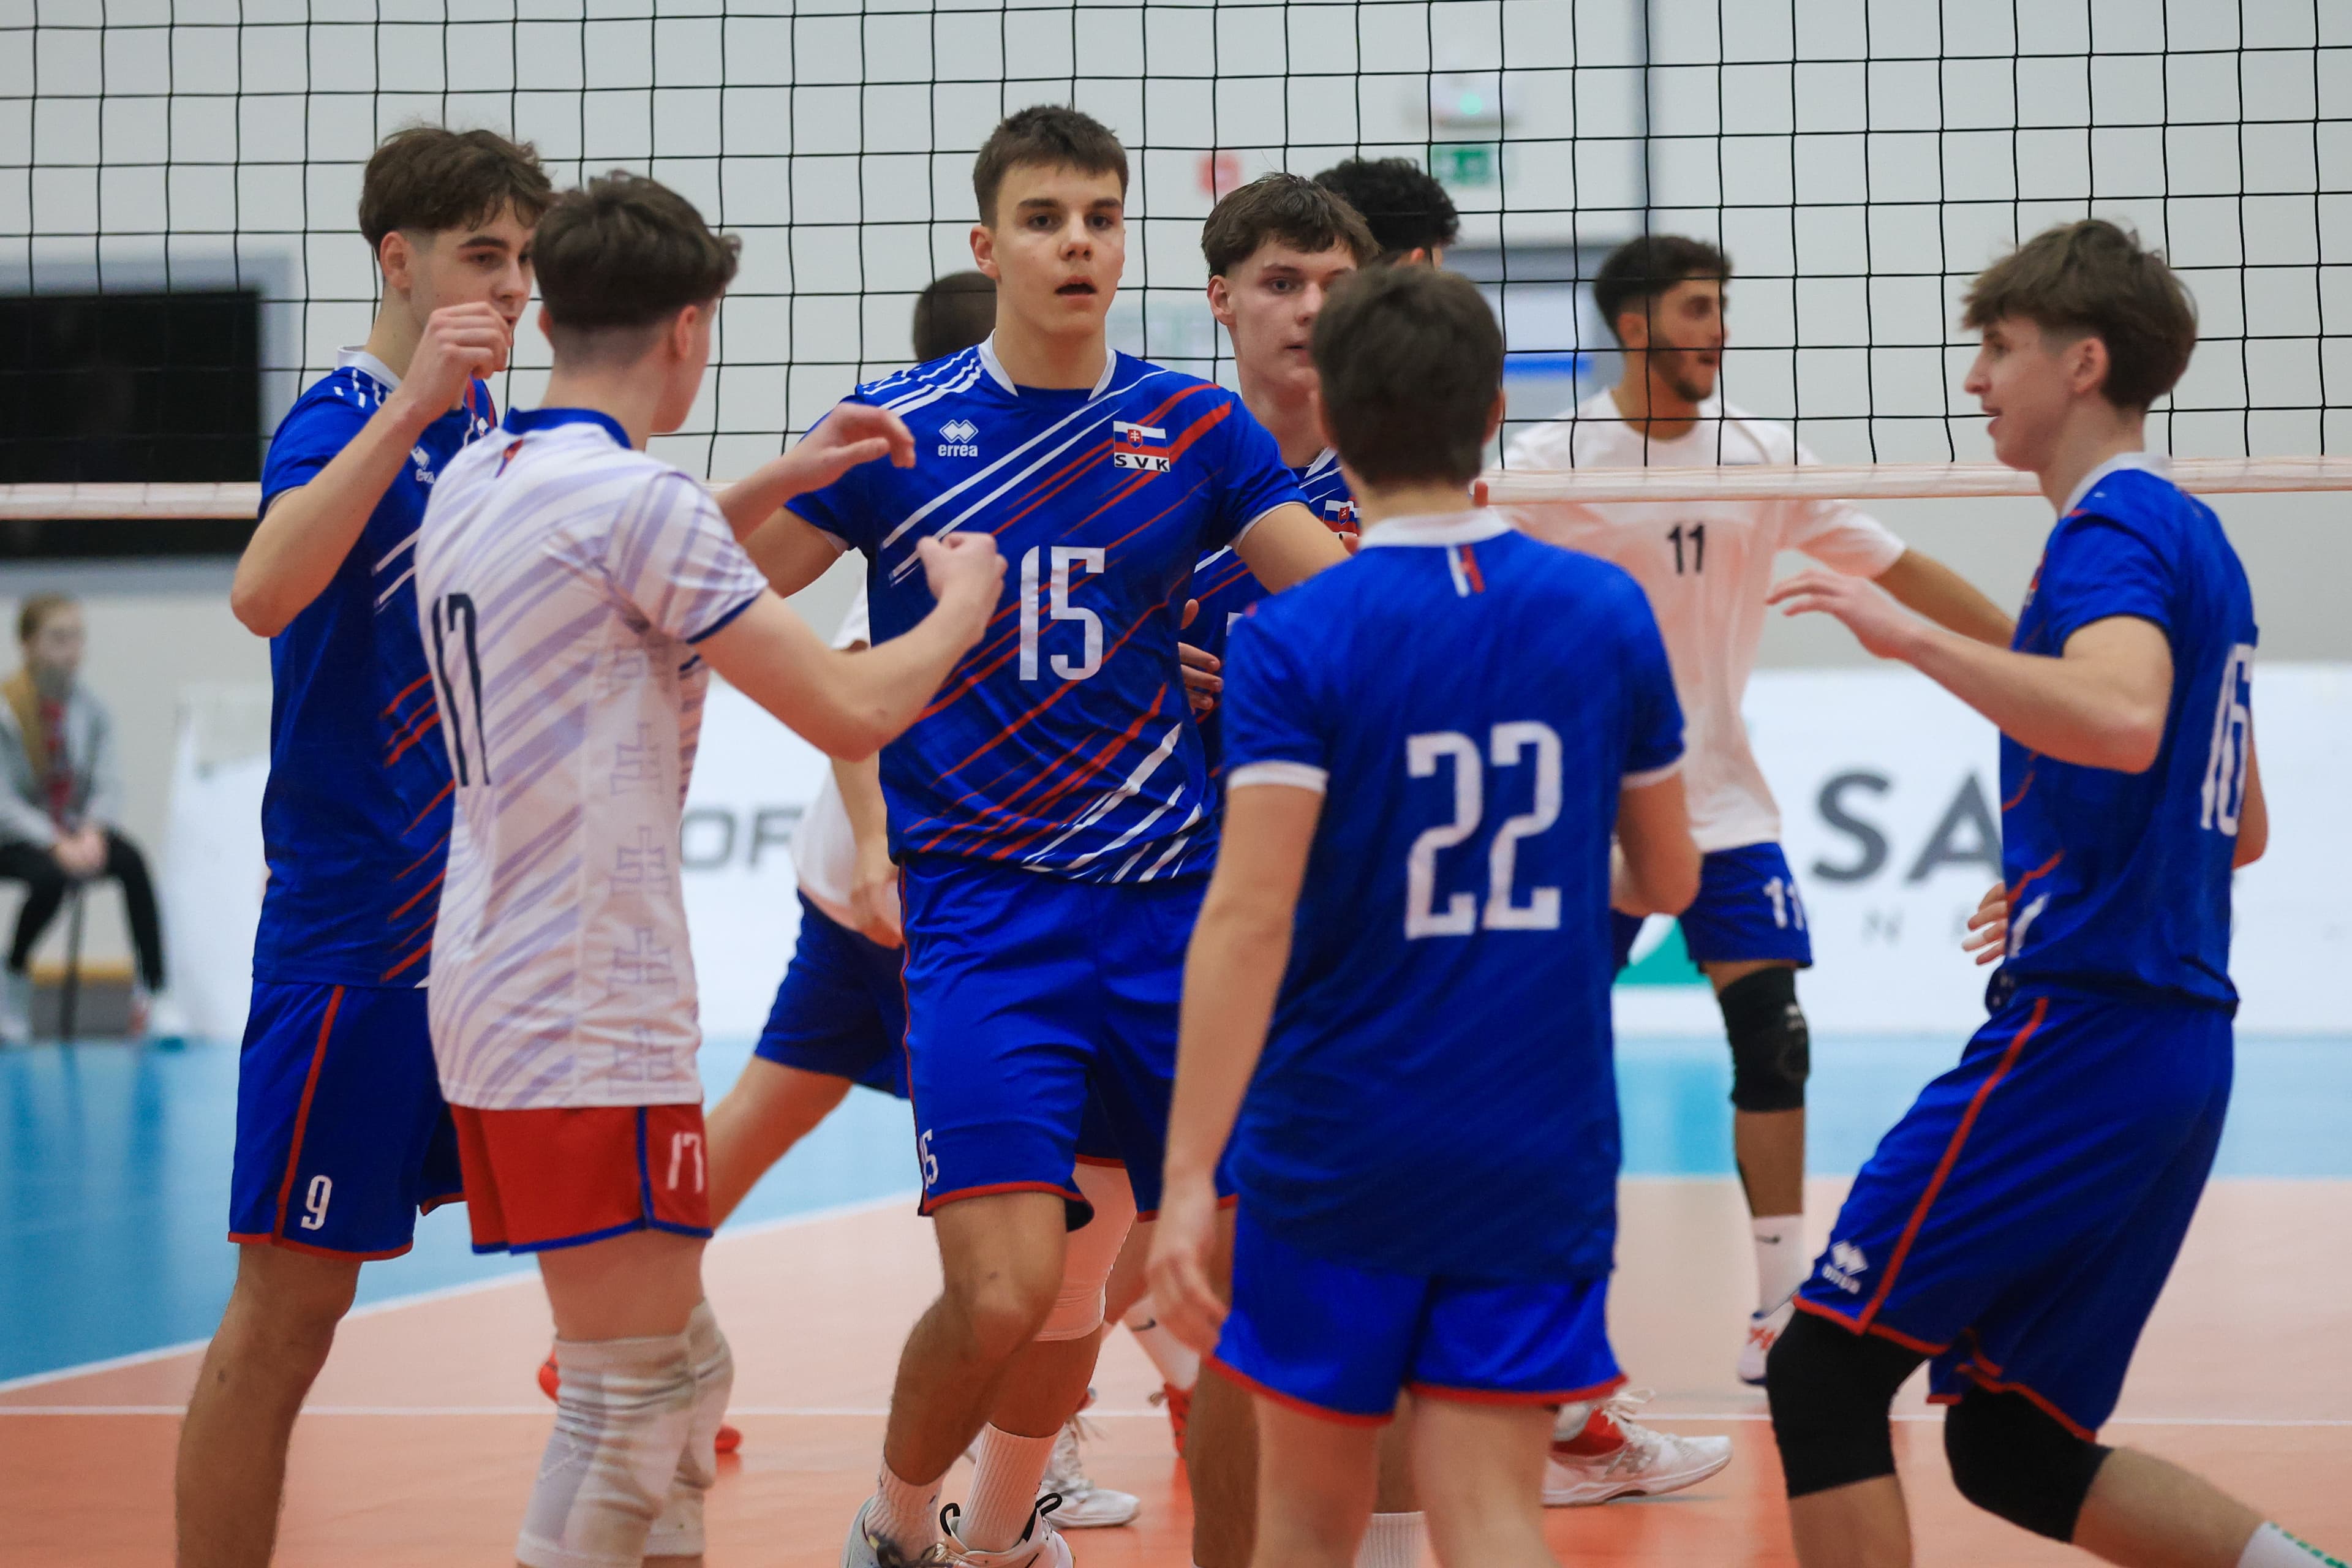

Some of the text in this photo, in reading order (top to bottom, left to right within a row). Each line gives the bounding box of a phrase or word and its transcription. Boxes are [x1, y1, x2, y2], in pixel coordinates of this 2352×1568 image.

[938, 444, 978, 457] errea
[1115, 454, 1169, 471] SVK
[1666, 524, 1705, 574] 11
[1019, 545, 1105, 680] 15
[431, 593, 490, 786] 17
[2200, 643, 2253, 836] 16
[1405, 721, 1562, 940] 22
[1763, 876, 1804, 930] 11
[666, 1132, 704, 1194] 17
[300, 1175, 333, 1231] 9
